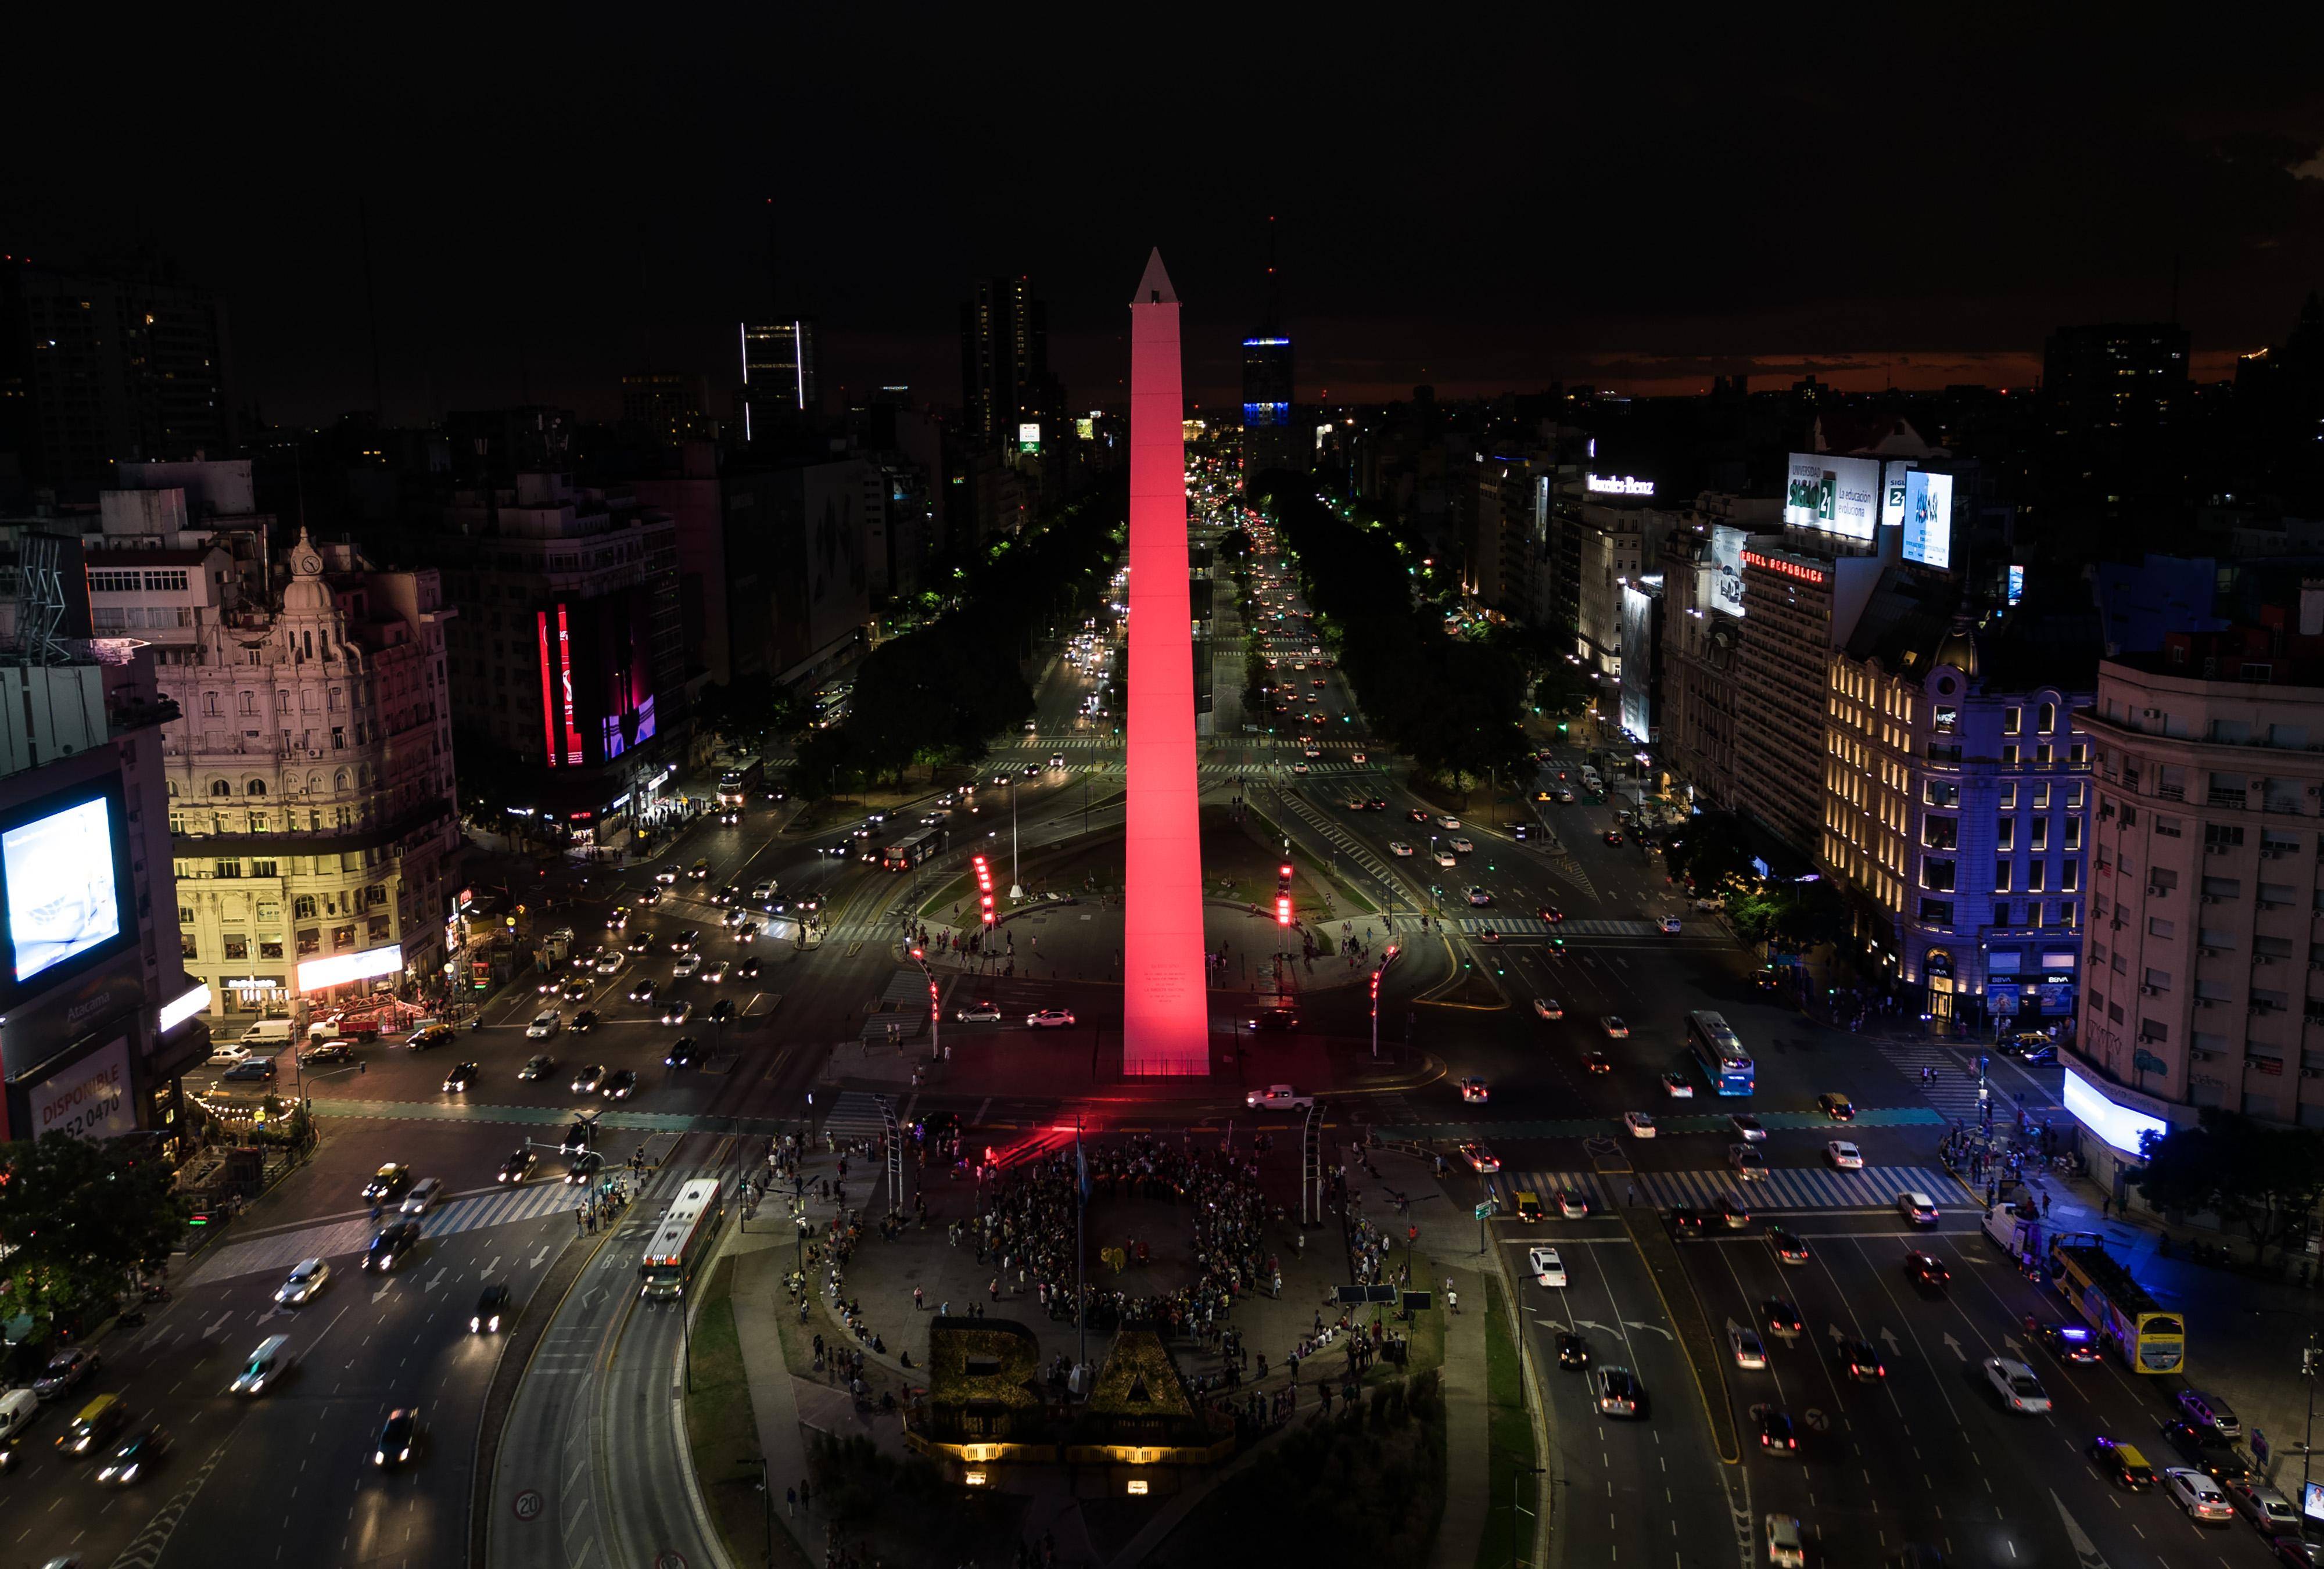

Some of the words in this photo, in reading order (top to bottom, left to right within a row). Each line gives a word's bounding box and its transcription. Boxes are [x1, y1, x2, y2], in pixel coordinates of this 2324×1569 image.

[1792, 465, 1821, 477] UNIVERSIDAD
[1788, 479, 1820, 509] SIGLO
[1820, 487, 1831, 519] 21
[1839, 488, 1844, 499] La
[1845, 489, 1871, 504] educación
[1838, 504, 1865, 517] evoluciona
[67, 992, 110, 1022] Atacama
[43, 1064, 119, 1125] DISPONIBLE
[86, 1094, 119, 1128] 0470
[520, 1495, 537, 1514] 20
